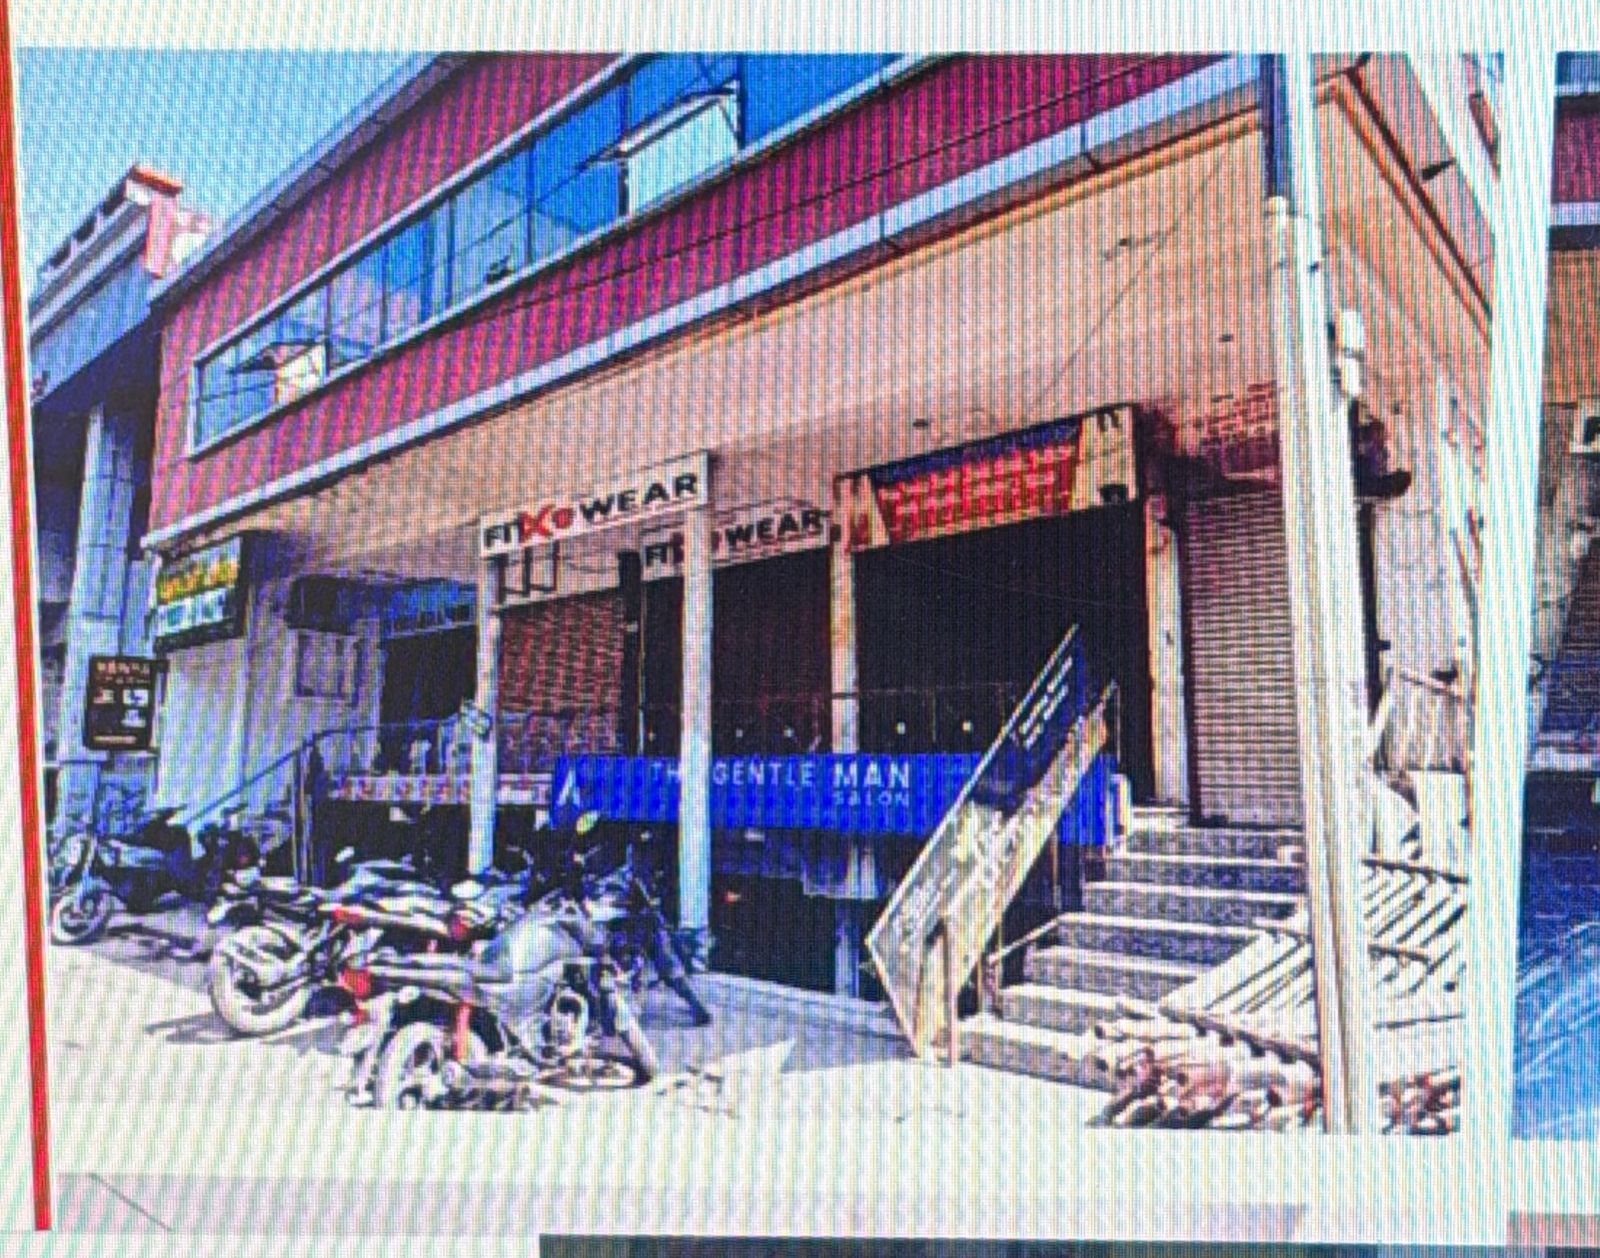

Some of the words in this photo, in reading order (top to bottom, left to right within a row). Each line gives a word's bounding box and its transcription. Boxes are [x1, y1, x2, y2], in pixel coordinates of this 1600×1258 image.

[579, 472, 698, 521] WEAR
[725, 510, 822, 546] WEAR
[713, 761, 815, 786] GENTLE
[834, 761, 910, 788] MAN
